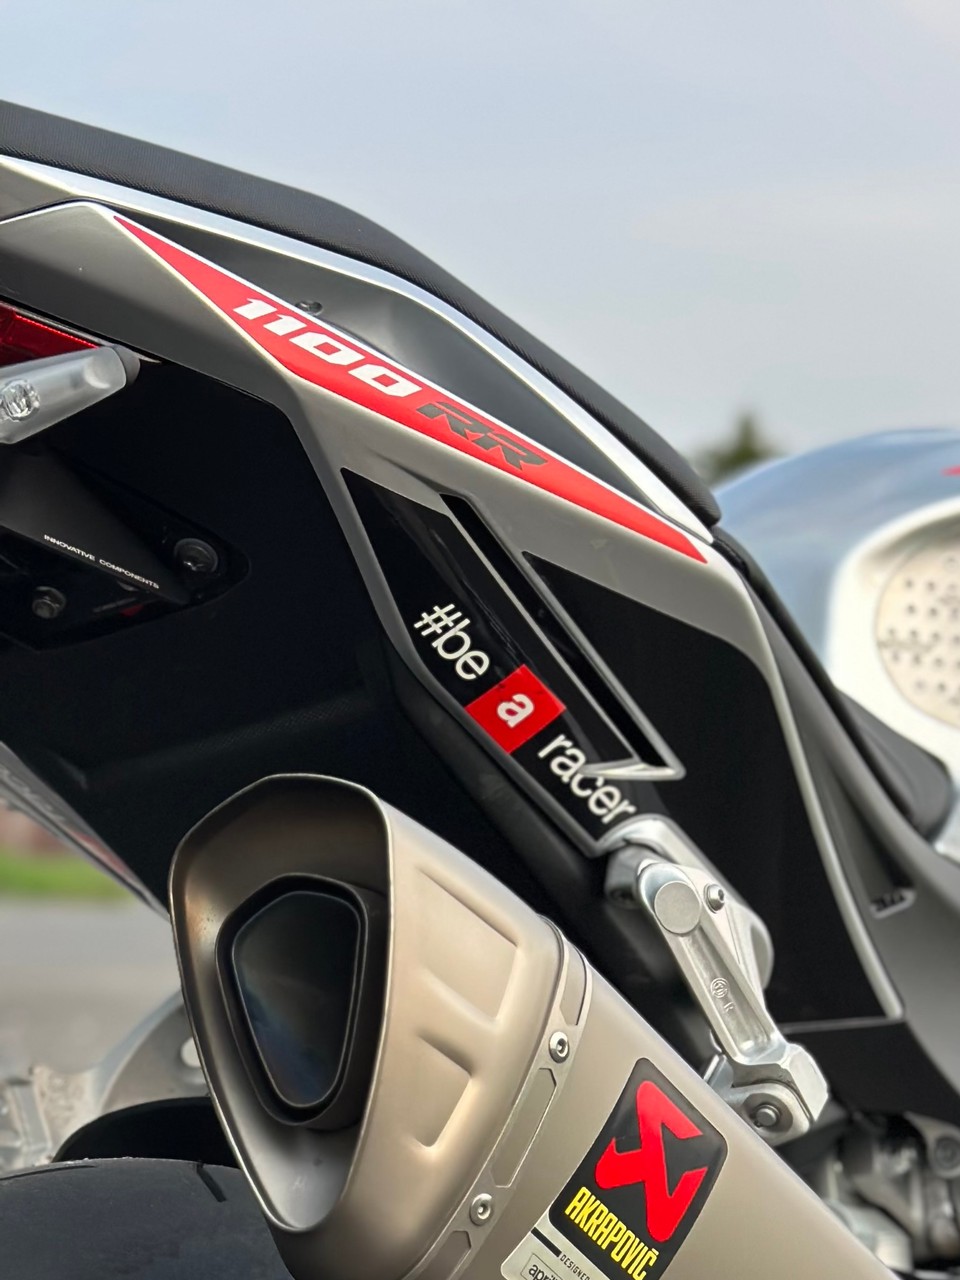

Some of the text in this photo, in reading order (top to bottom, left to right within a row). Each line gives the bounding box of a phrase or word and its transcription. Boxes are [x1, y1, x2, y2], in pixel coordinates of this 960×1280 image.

[233, 298, 548, 470] 1100 RR
[44, 534, 160, 589] INNOVATIVE COMPONENTS
[413, 603, 637, 824] #be a racer
